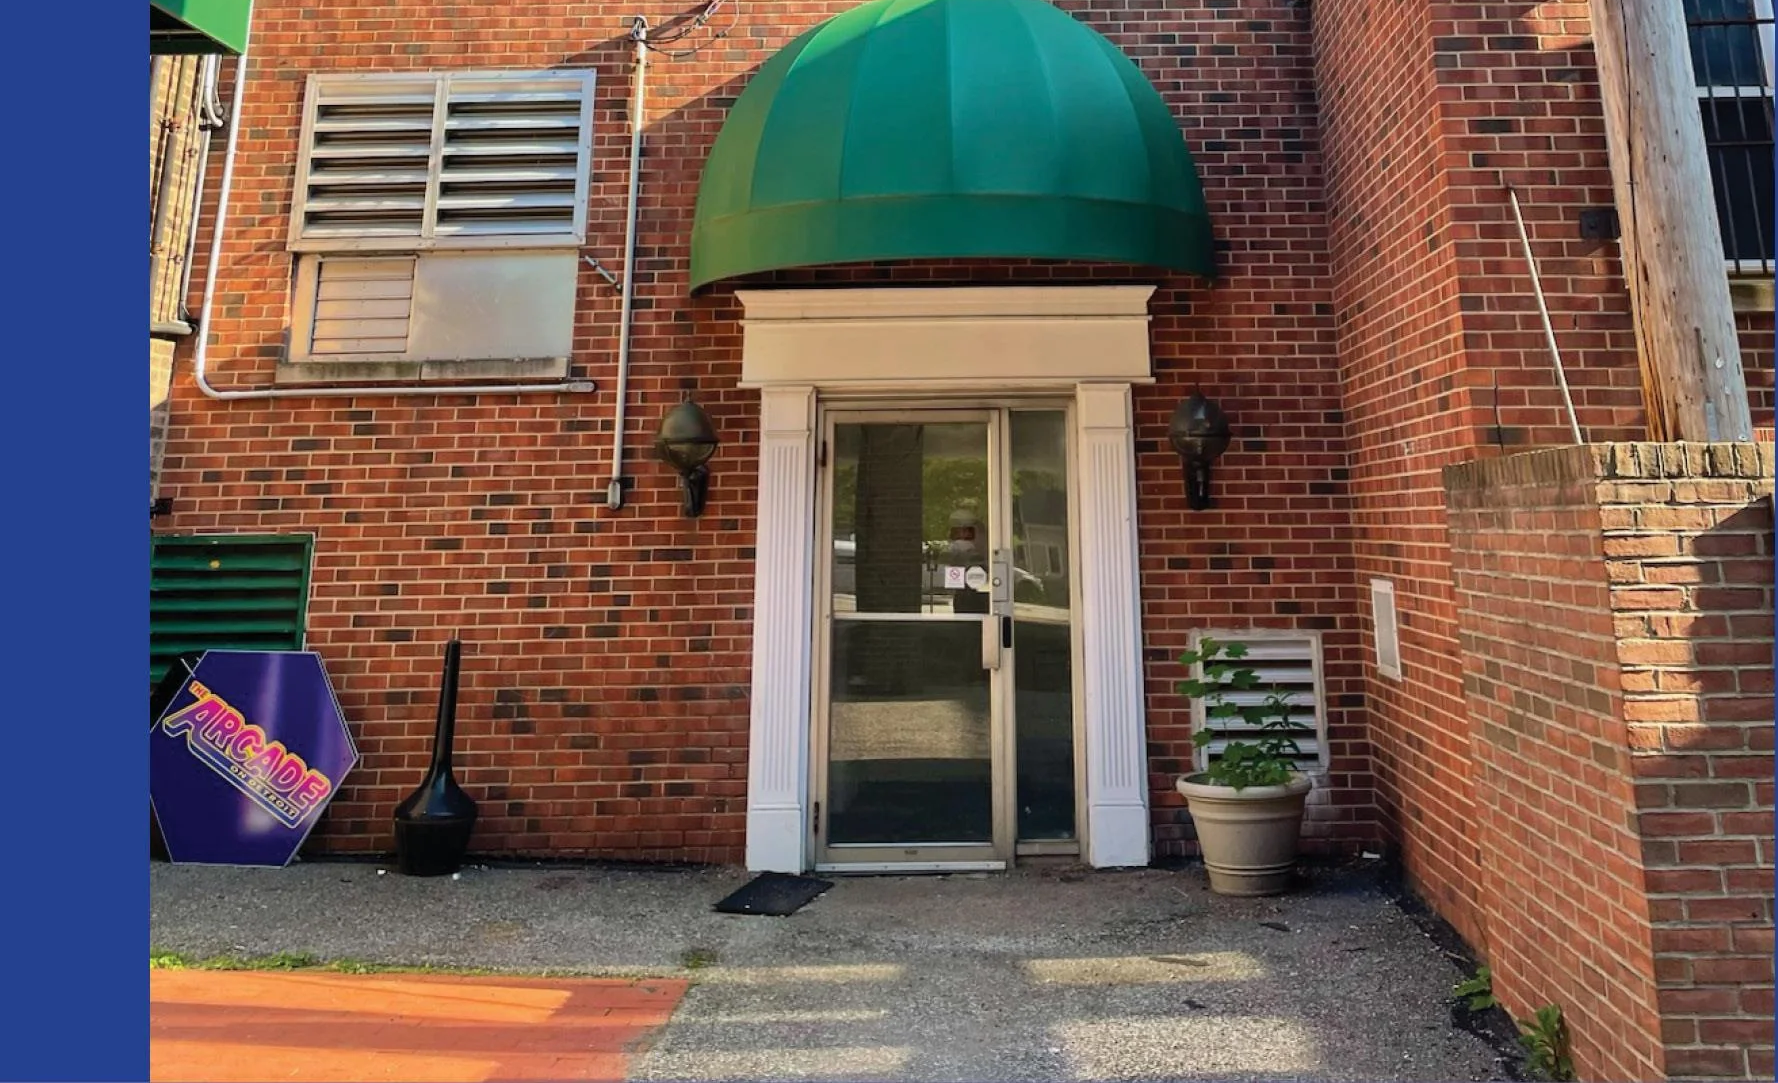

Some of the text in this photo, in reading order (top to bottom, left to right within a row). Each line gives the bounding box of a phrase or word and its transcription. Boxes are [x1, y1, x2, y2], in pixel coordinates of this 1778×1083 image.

[163, 695, 331, 810] ARCADE
[230, 764, 297, 816] ON DETROIT
